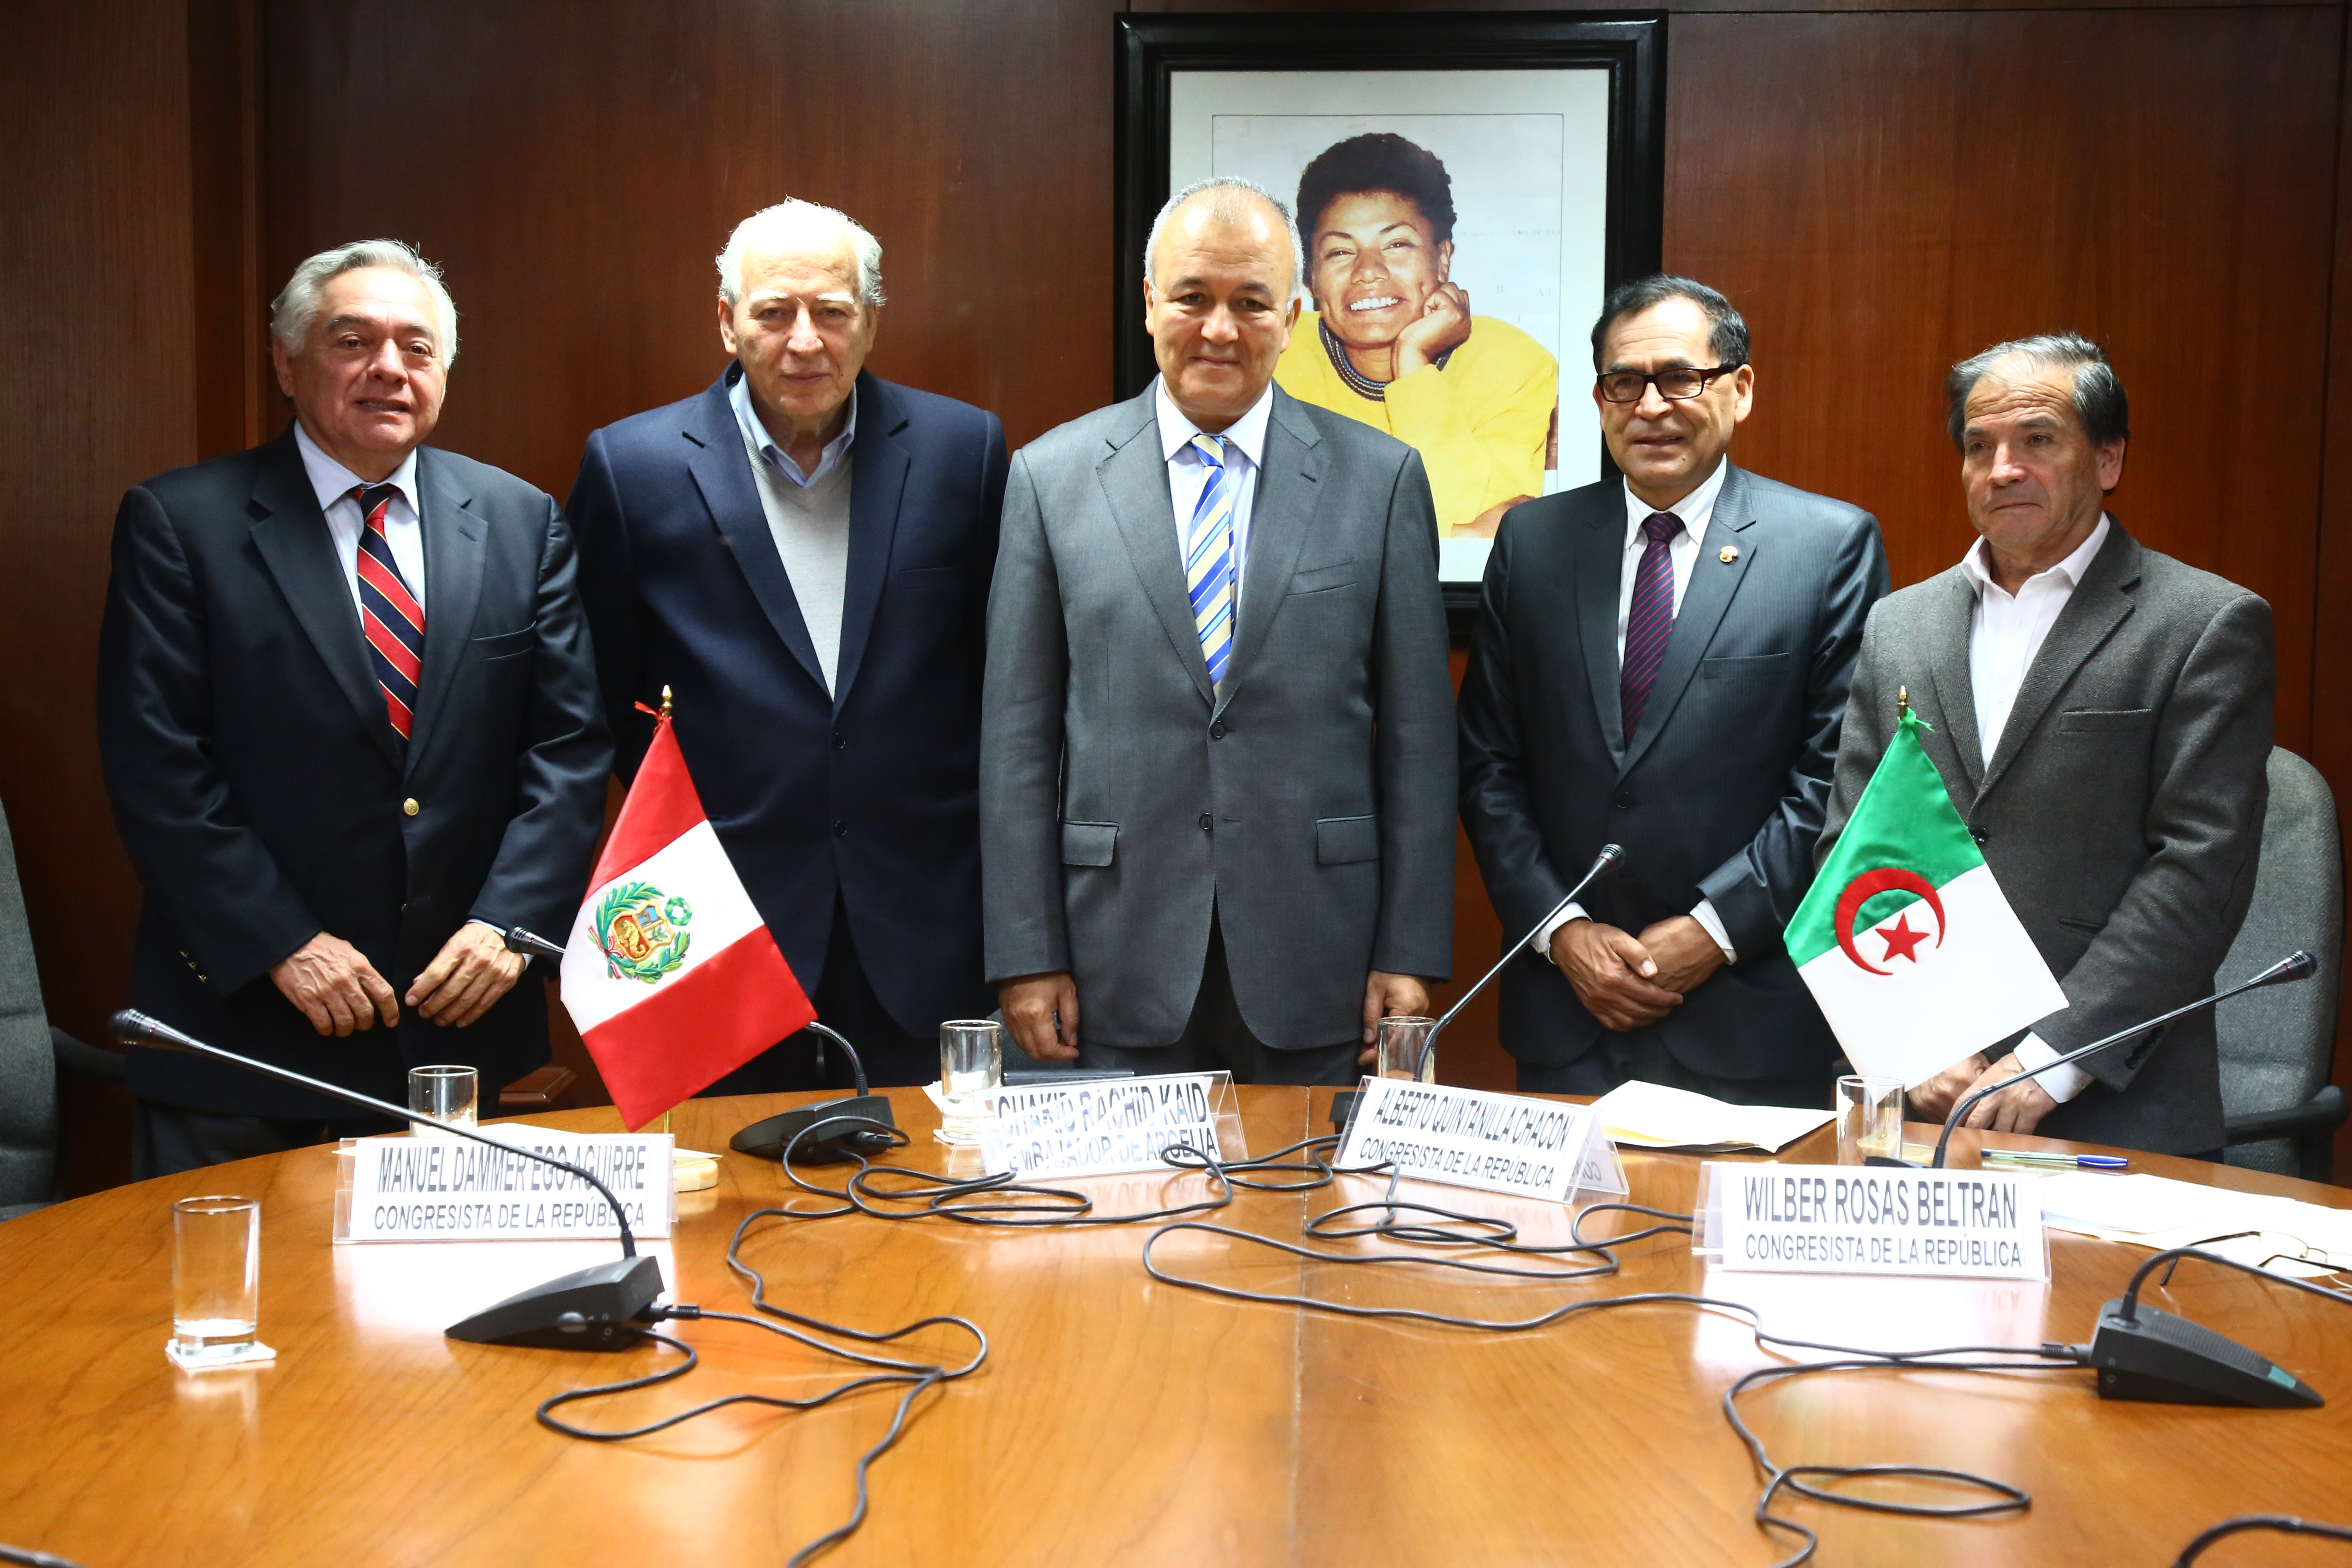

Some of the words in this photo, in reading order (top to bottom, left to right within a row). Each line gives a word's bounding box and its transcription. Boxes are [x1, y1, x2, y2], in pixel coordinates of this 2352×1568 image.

[1159, 1083, 1207, 1125] KAID
[1373, 1088, 1436, 1130] ALBERTO
[1432, 1096, 1517, 1142] QUINTANILLA
[1512, 1108, 1575, 1152] CHACON
[377, 1147, 448, 1193] MANUEL
[452, 1146, 527, 1192] DAMMER
[531, 1145, 567, 1191] EGO
[570, 1145, 646, 1191] AGUIRRE
[1117, 1134, 1142, 1163] DE
[1360, 1137, 1443, 1170] CONGRESISTA
[1443, 1150, 1464, 1173] DE
[1462, 1153, 1482, 1177] LA
[1481, 1155, 1555, 1189] REPÚBLICA
[374, 1204, 493, 1230] CONGRESISTA
[498, 1204, 520, 1229] DE
[525, 1204, 545, 1228] LA
[551, 1196, 644, 1228] REPÚBLCA
[1744, 1176, 1827, 1223] WILBER
[1835, 1179, 1909, 1225] ROSAS
[1917, 1181, 2017, 1229] BELTRAN
[1746, 1234, 1865, 1263] CONGRESISTA
[1871, 1238, 1893, 1263] DE
[1899, 1239, 1920, 1265] LA
[1925, 1233, 2022, 1268] REPÚBLICA
